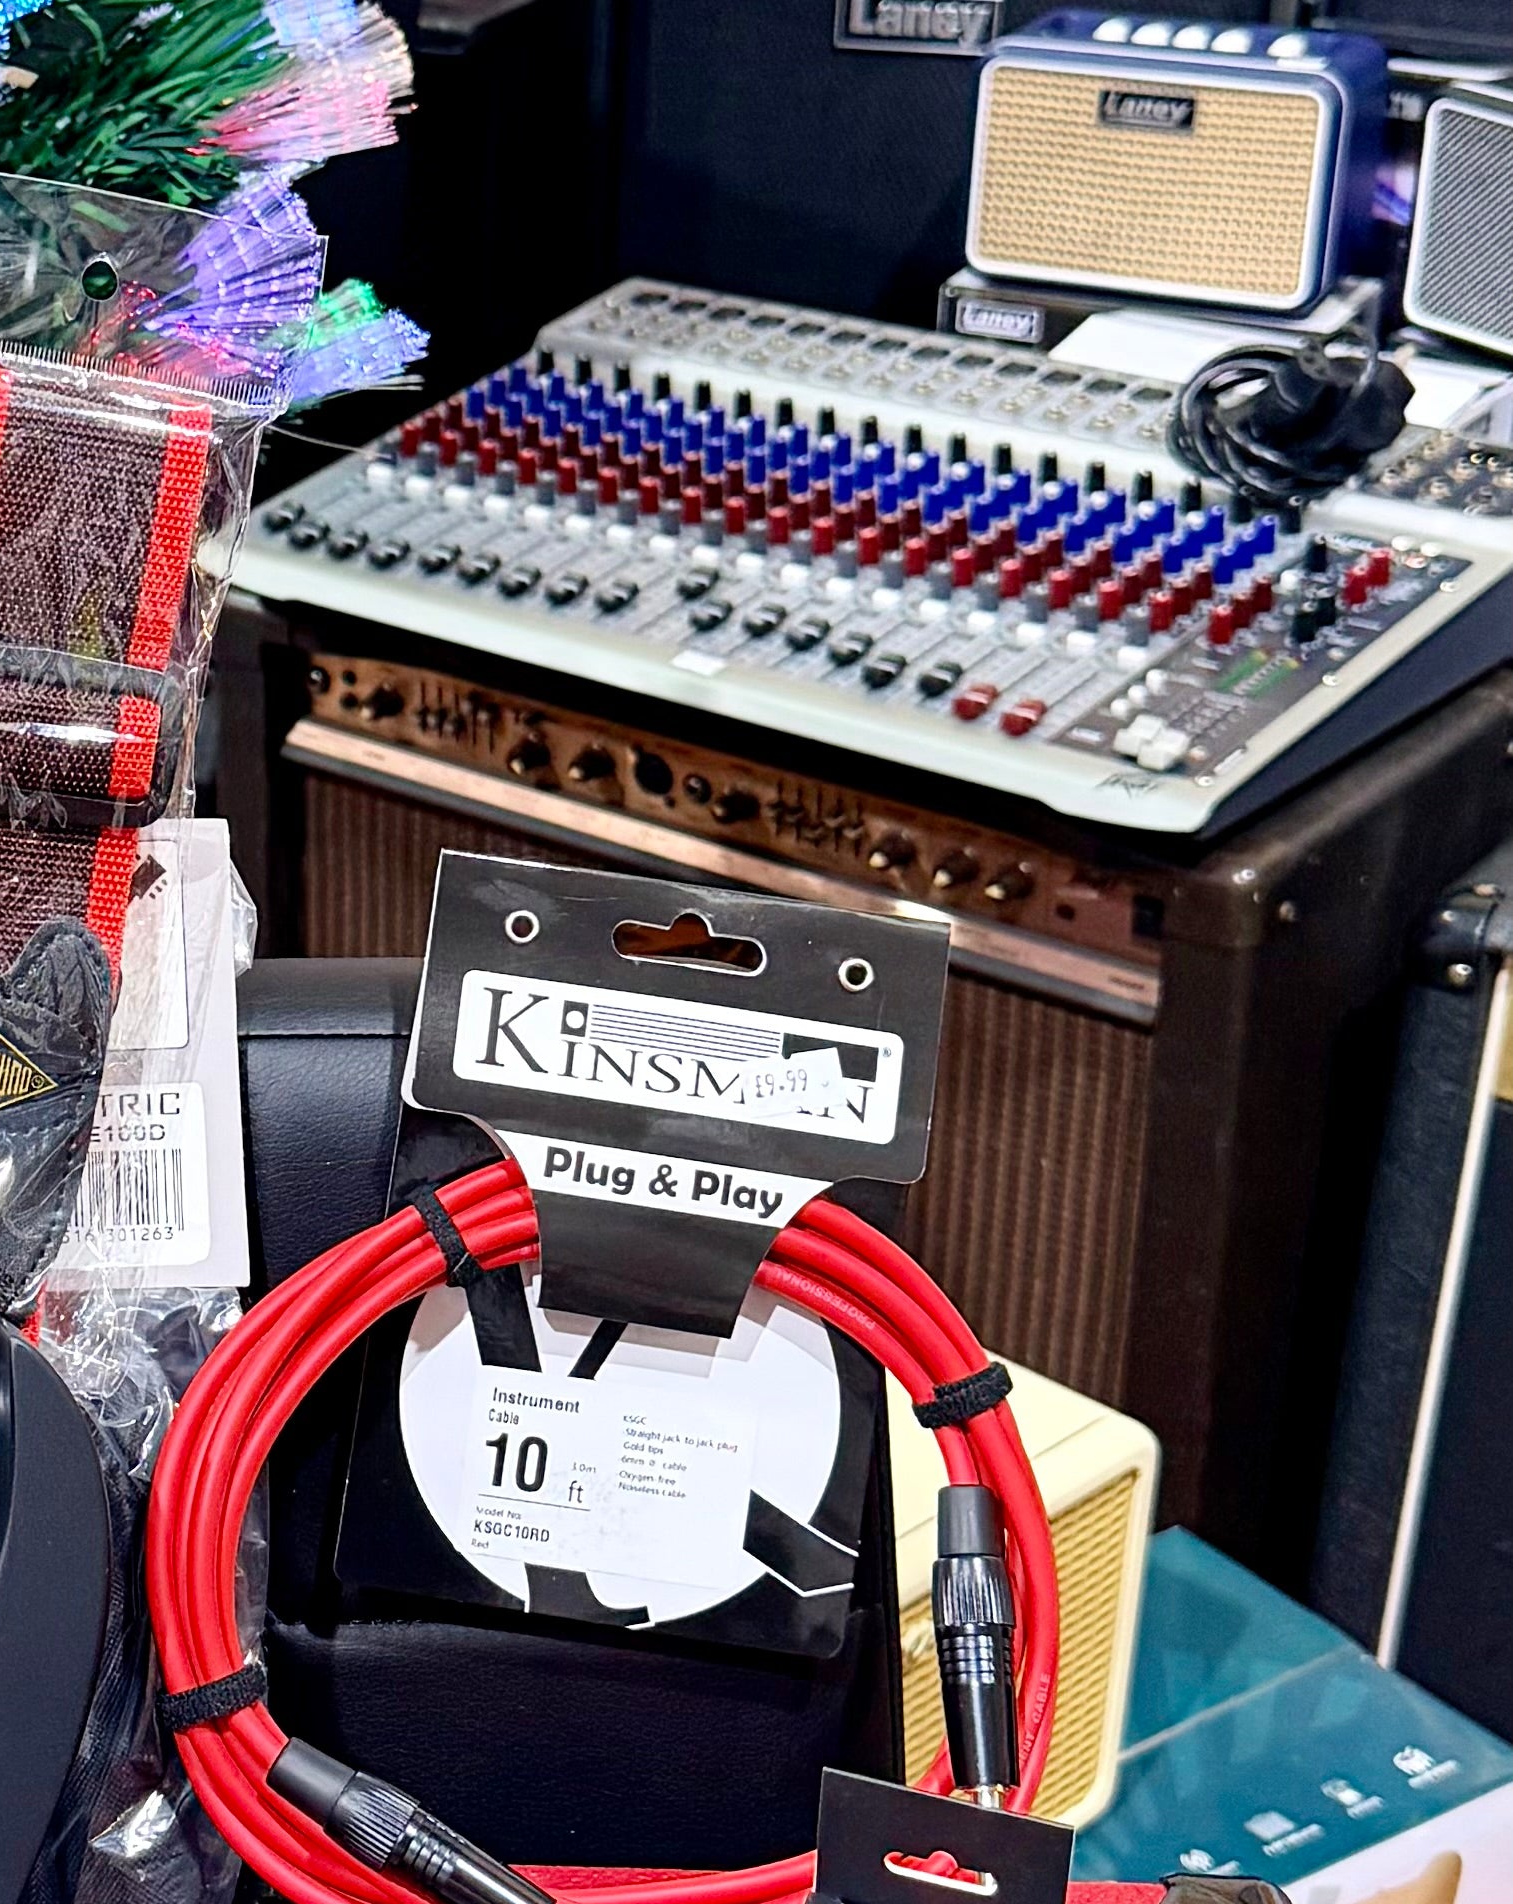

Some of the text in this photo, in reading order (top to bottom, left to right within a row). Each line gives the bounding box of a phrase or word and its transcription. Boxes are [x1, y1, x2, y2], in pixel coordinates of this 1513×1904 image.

[1103, 92, 1191, 126] Laney
[756, 1069, 808, 1098] £9.99
[100, 1093, 180, 1117] TRIC
[90, 1124, 165, 1143] E100D
[544, 1146, 784, 1219] Plug & Play
[493, 1387, 580, 1413] Instrument
[488, 1408, 520, 1425] Cable
[485, 1432, 548, 1493] 10
[568, 1480, 584, 1503] ft
[473, 1519, 550, 1542] KSGC10RD
